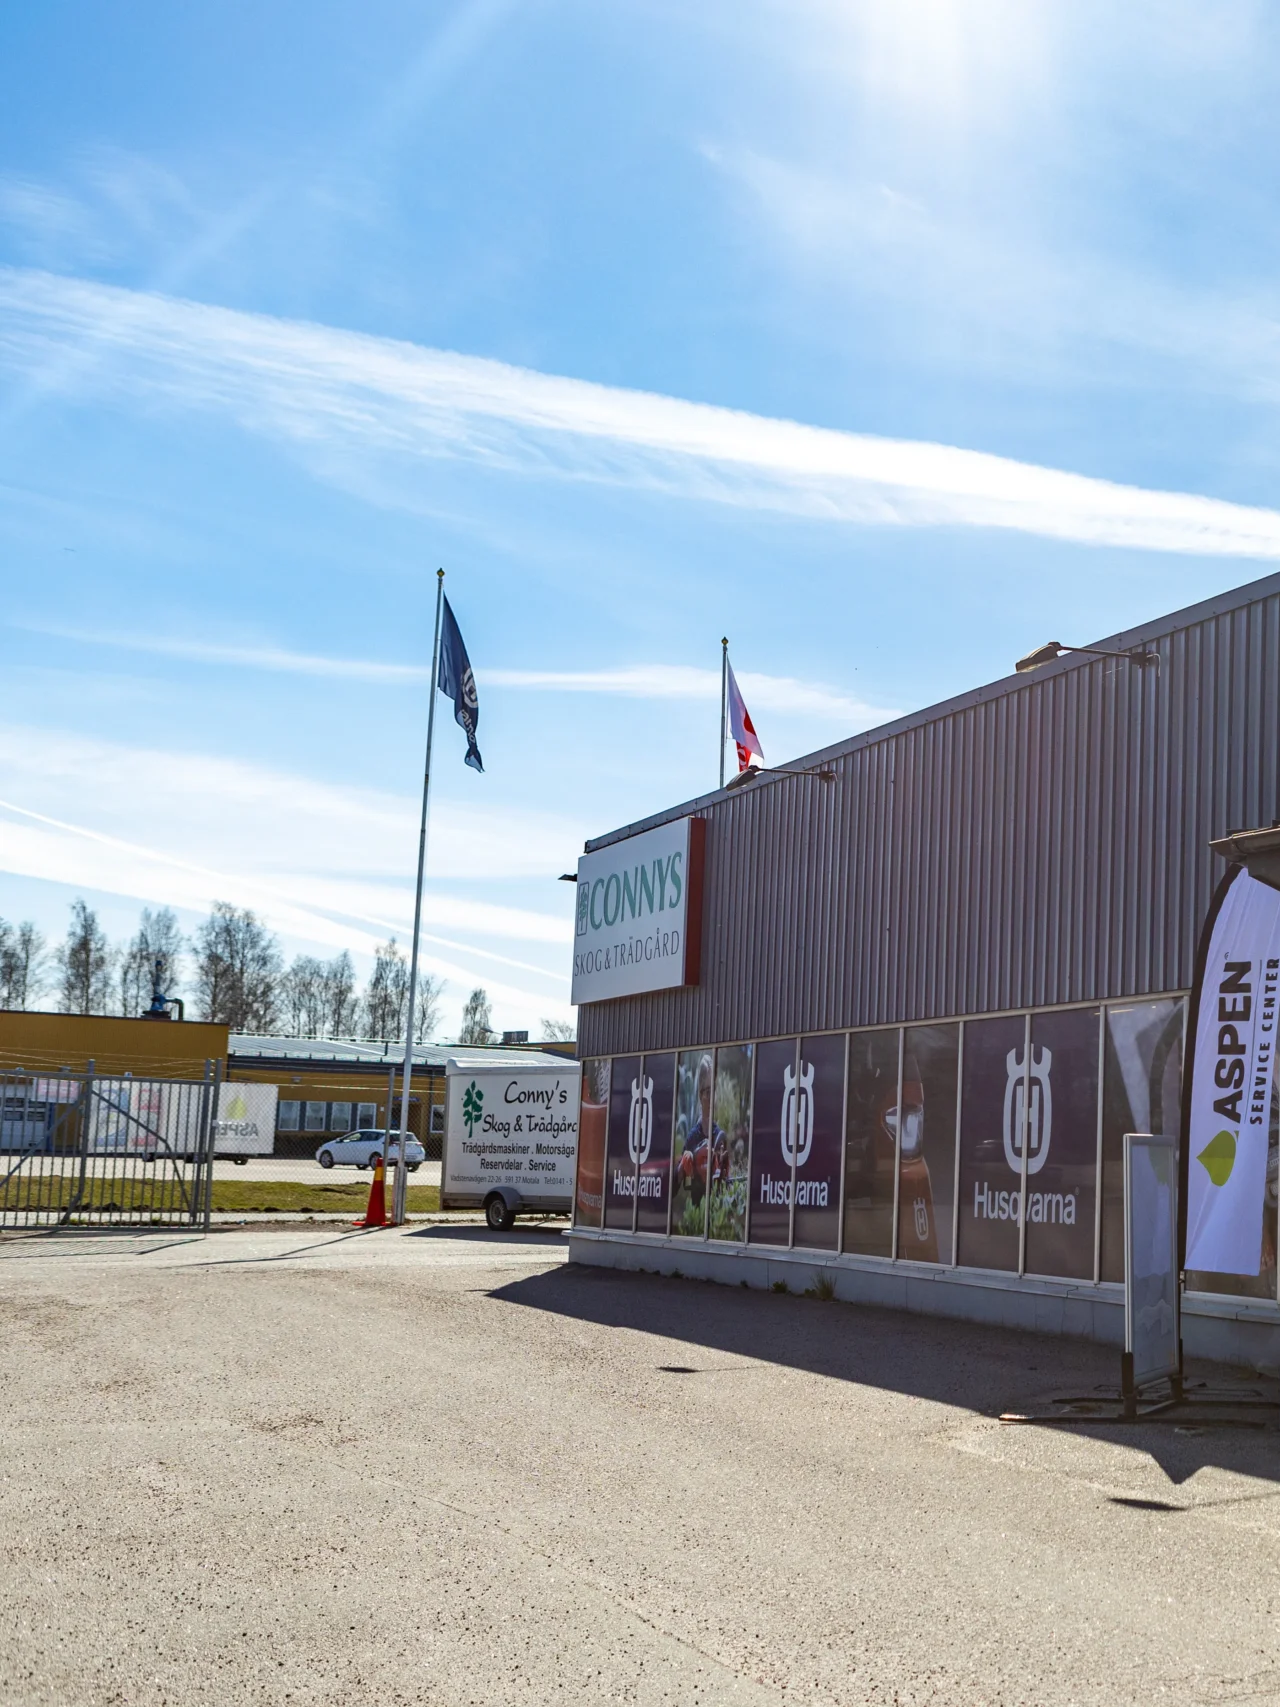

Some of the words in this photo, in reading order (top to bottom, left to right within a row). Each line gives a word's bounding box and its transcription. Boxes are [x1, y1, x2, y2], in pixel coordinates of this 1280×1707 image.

[589, 851, 682, 930] CONNYS
[574, 948, 602, 977] SKOG
[605, 947, 611, 970] &
[614, 927, 680, 968] TRÄDGÅRD
[1213, 961, 1252, 1124] ASPEN
[1250, 1042, 1270, 1125] SERVICE
[1261, 958, 1280, 1032] CENTER
[504, 1080, 567, 1110] Conny's
[482, 1114, 510, 1138] Skog
[514, 1115, 523, 1132] &
[462, 1142, 530, 1158] Trädgårdsmaskiner
[480, 1158, 523, 1170] Reservdelar
[529, 1159, 556, 1172] Service
[613, 1169, 661, 1199] Husqvarna
[760, 1173, 828, 1210] Husqvarna
[973, 1181, 1076, 1228] Husqvarna
